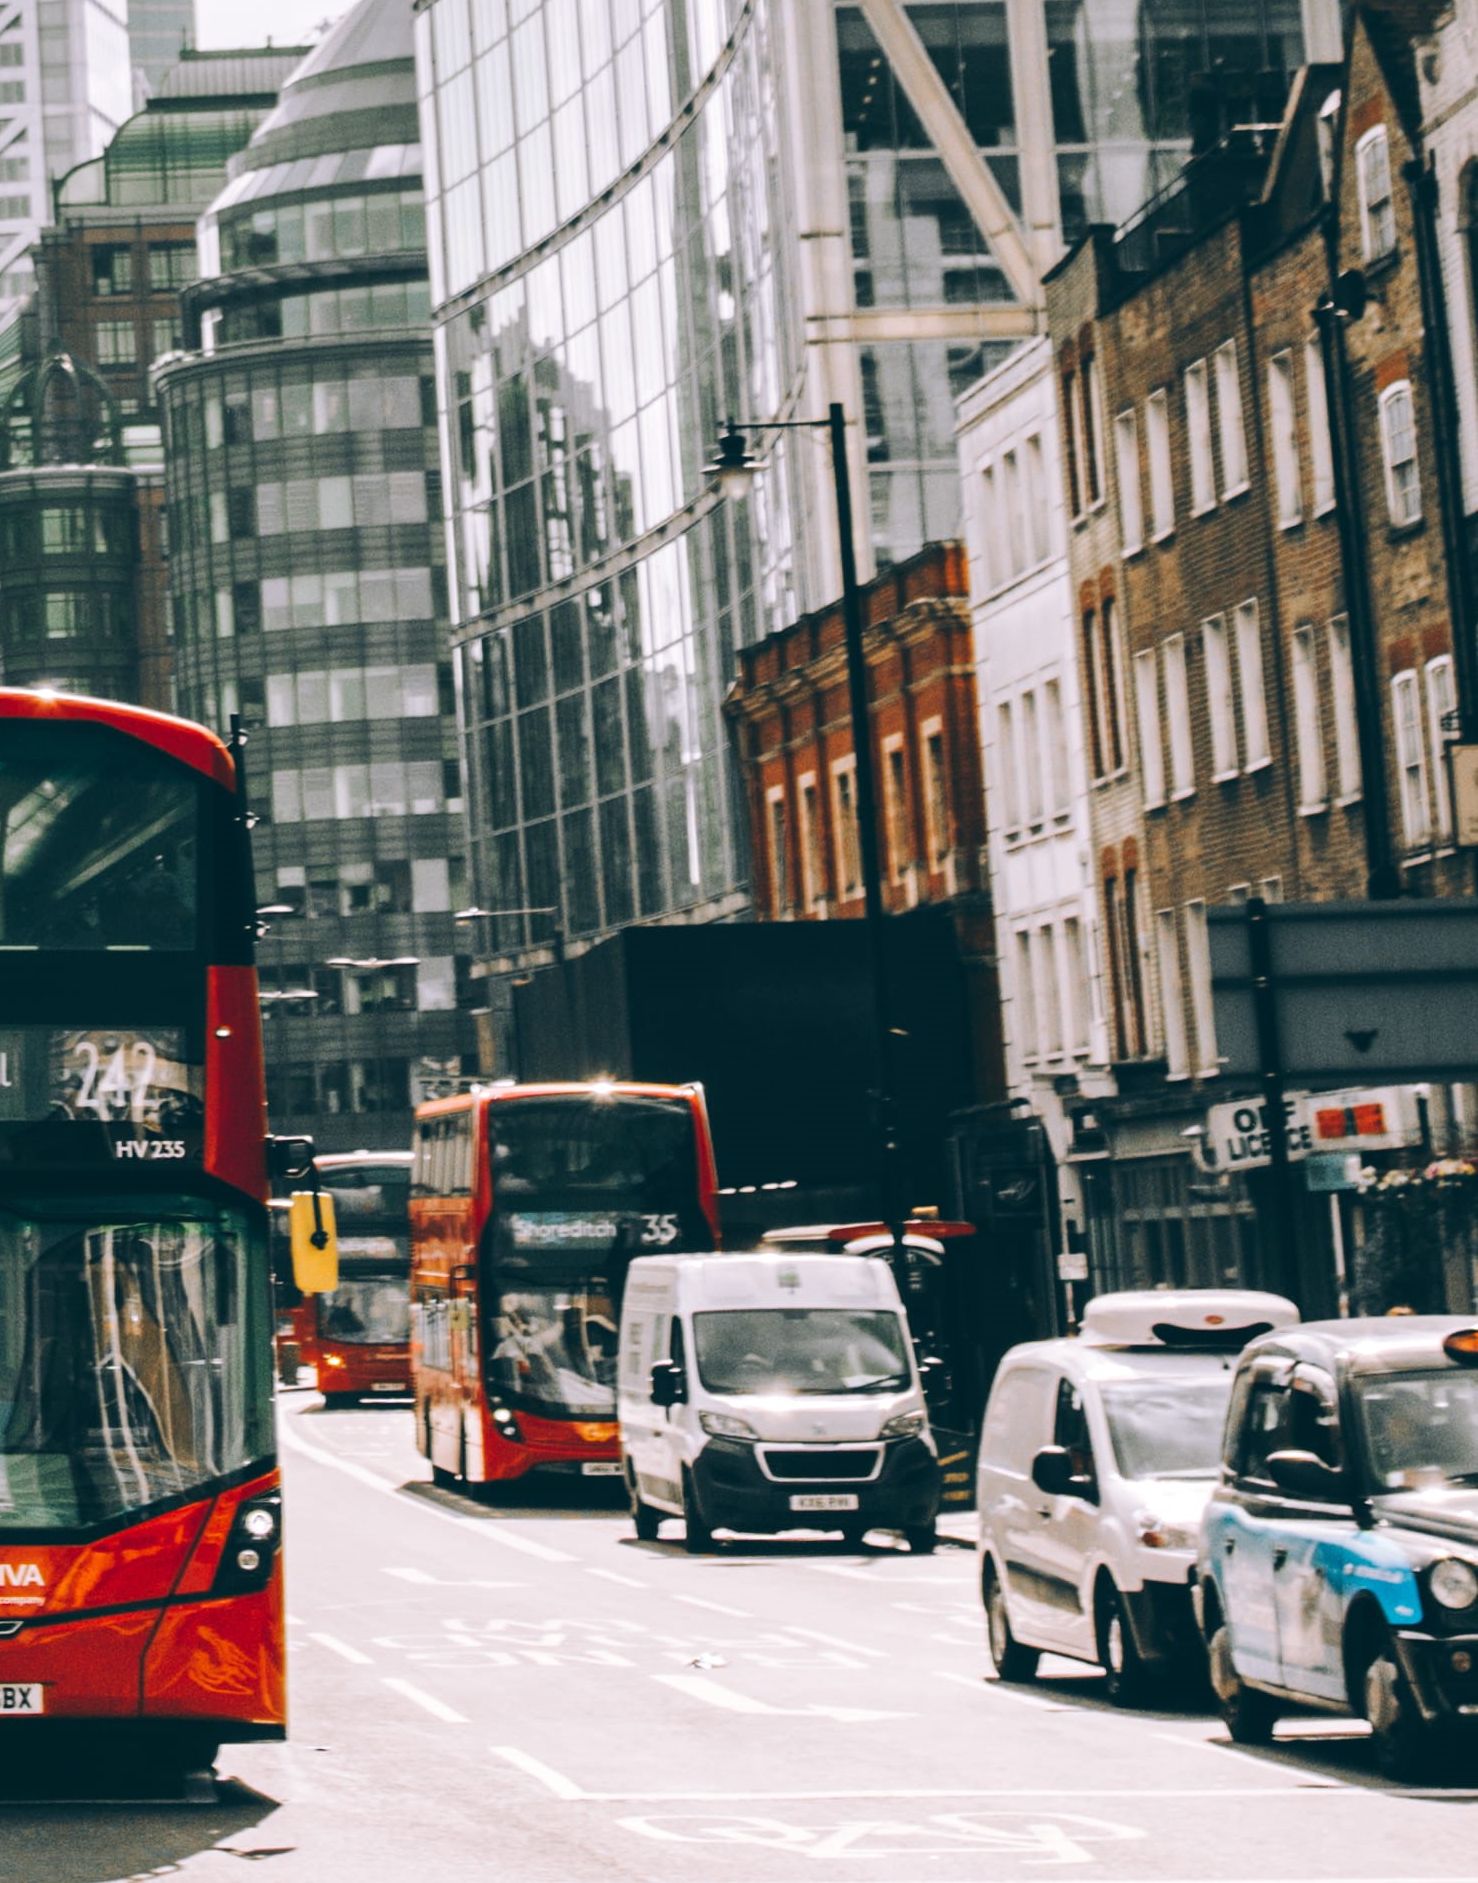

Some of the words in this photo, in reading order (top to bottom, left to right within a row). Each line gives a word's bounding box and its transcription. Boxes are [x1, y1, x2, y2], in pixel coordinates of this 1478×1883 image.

[74, 1041, 159, 1108] 242
[1226, 1125, 1313, 1161] LICECE
[513, 1219, 617, 1238] Shoreditch
[640, 1213, 679, 1246] 35
